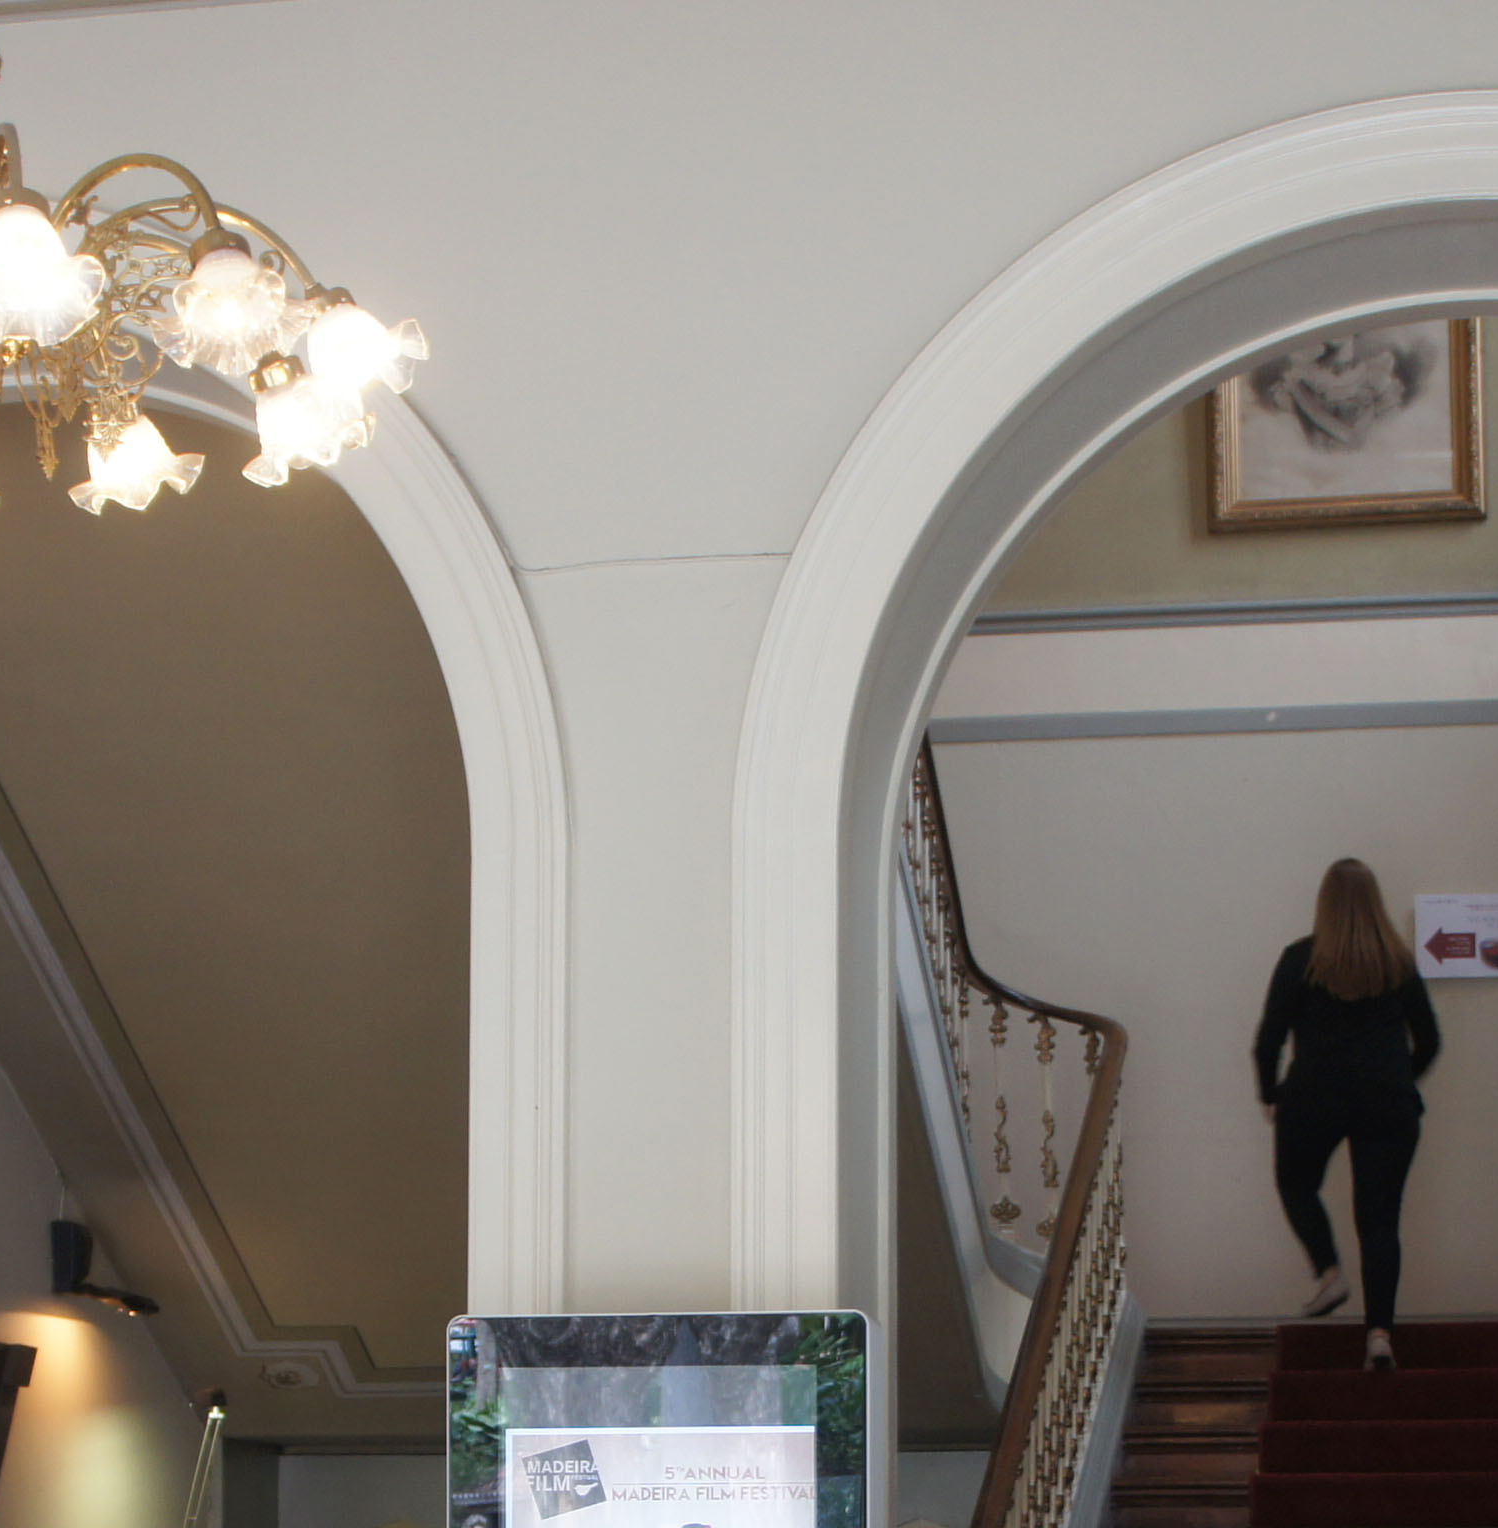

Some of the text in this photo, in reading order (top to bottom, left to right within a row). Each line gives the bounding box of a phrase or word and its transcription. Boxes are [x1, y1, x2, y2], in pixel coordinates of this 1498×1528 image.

[527, 1459, 598, 1474] MADEIRA
[685, 1466, 766, 1481] ANNUAL
[527, 1475, 571, 1492] FILM
[612, 1486, 816, 1501] MADEIRA FILM FESTIVAL
